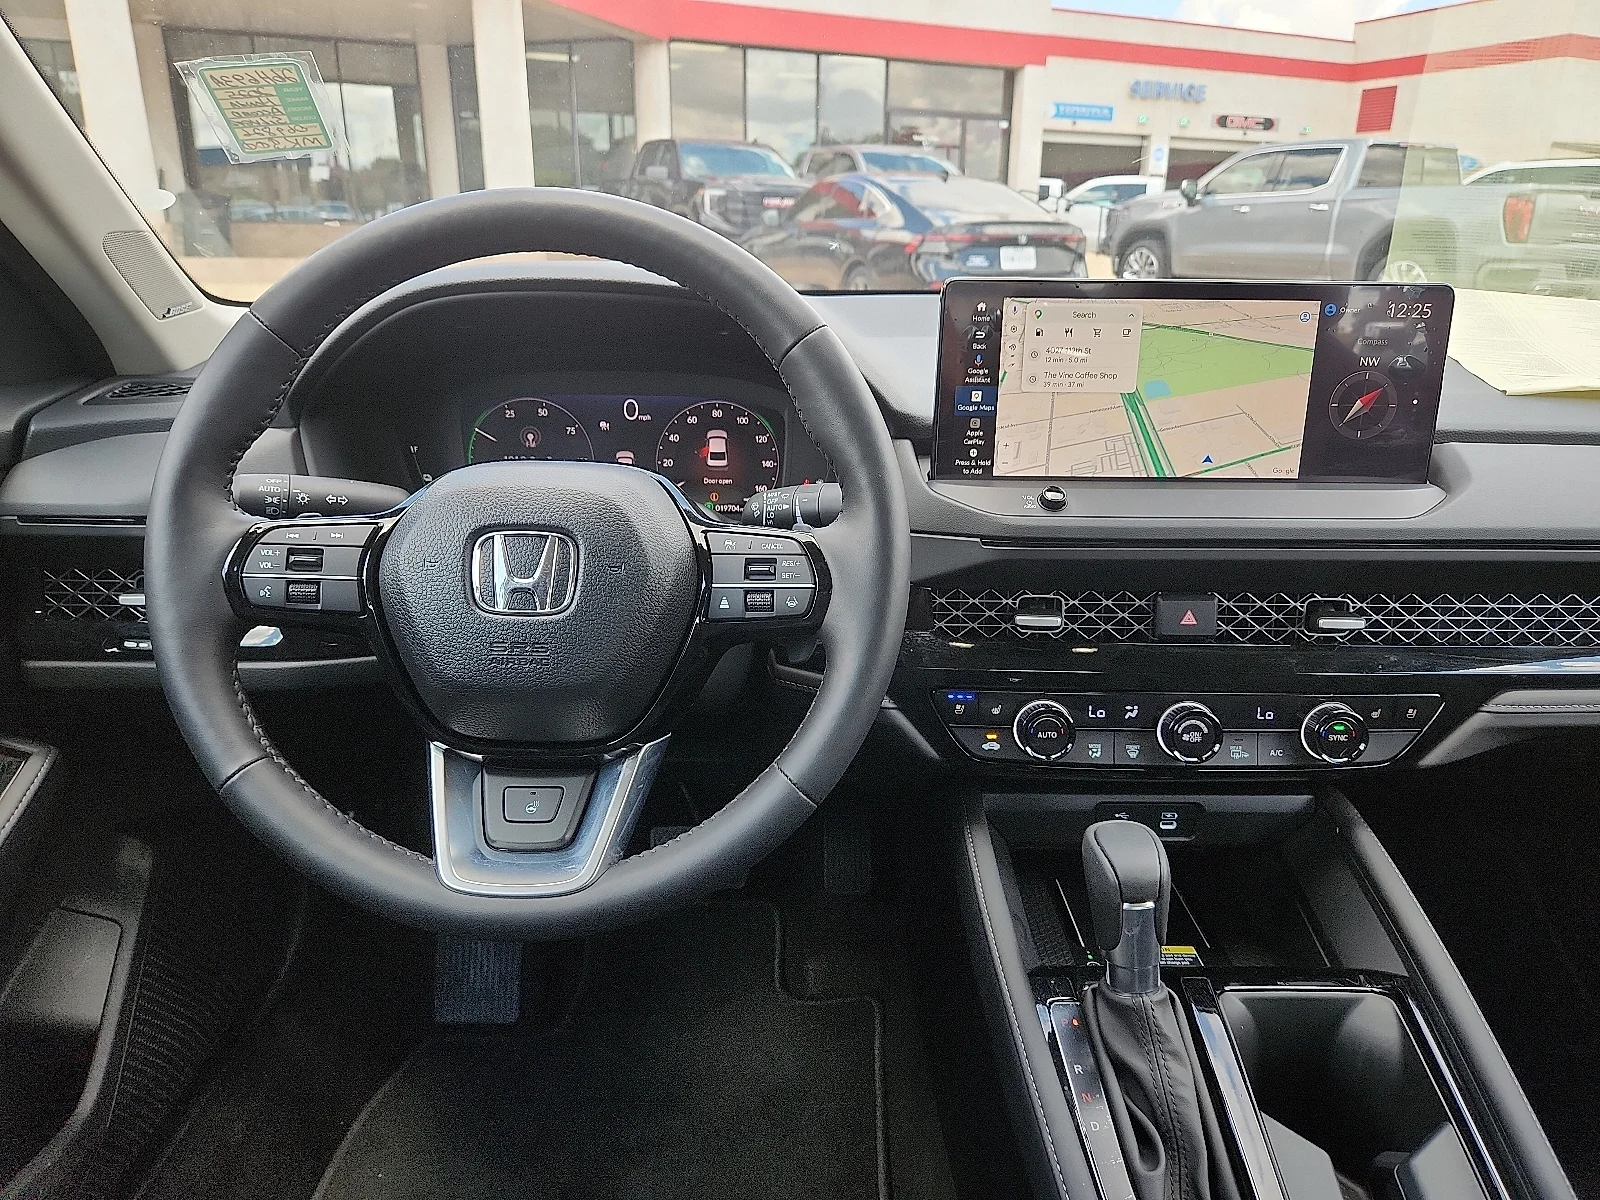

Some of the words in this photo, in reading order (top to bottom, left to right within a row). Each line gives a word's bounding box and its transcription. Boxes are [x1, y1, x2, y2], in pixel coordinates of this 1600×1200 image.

[1130, 79, 1207, 102] SERVICE
[1387, 303, 1432, 318] 12:25
[972, 314, 991, 322] Home
[1072, 311, 1097, 319] Search
[1357, 337, 1388, 346] Compass
[1084, 347, 1092, 355] St
[1359, 356, 1380, 367] NW
[967, 368, 989, 376] Google
[1044, 371, 1057, 379] The
[1075, 371, 1098, 379] Coffee
[1099, 372, 1118, 380] Shop
[965, 376, 991, 384] Assistant
[623, 399, 639, 421] 0
[638, 414, 652, 422] mph
[957, 404, 978, 412] Google
[979, 404, 995, 412] Maps
[505, 410, 516, 418] 25
[537, 409, 548, 417] 50
[712, 410, 723, 418] 80
[687, 416, 698, 424] 60
[736, 416, 749, 425] 100
[565, 427, 576, 435] 75
[966, 430, 984, 438] Apple
[669, 434, 680, 442] 40
[755, 435, 768, 443] 120
[963, 438, 985, 446] CarPlay
[663, 459, 673, 467] 20
[761, 460, 774, 468] 140
[955, 459, 970, 467] Press
[755, 485, 767, 493] 160
[715, 504, 740, 512] 019704
[1088, 705, 1105, 718] Lo
[1257, 707, 1274, 720] Lo
[1037, 731, 1057, 739] AUTO
[1328, 734, 1348, 742] SYNC
[1074, 1064, 1083, 1075] R
[1081, 1092, 1092, 1103] N
[1090, 1121, 1100, 1132] D
